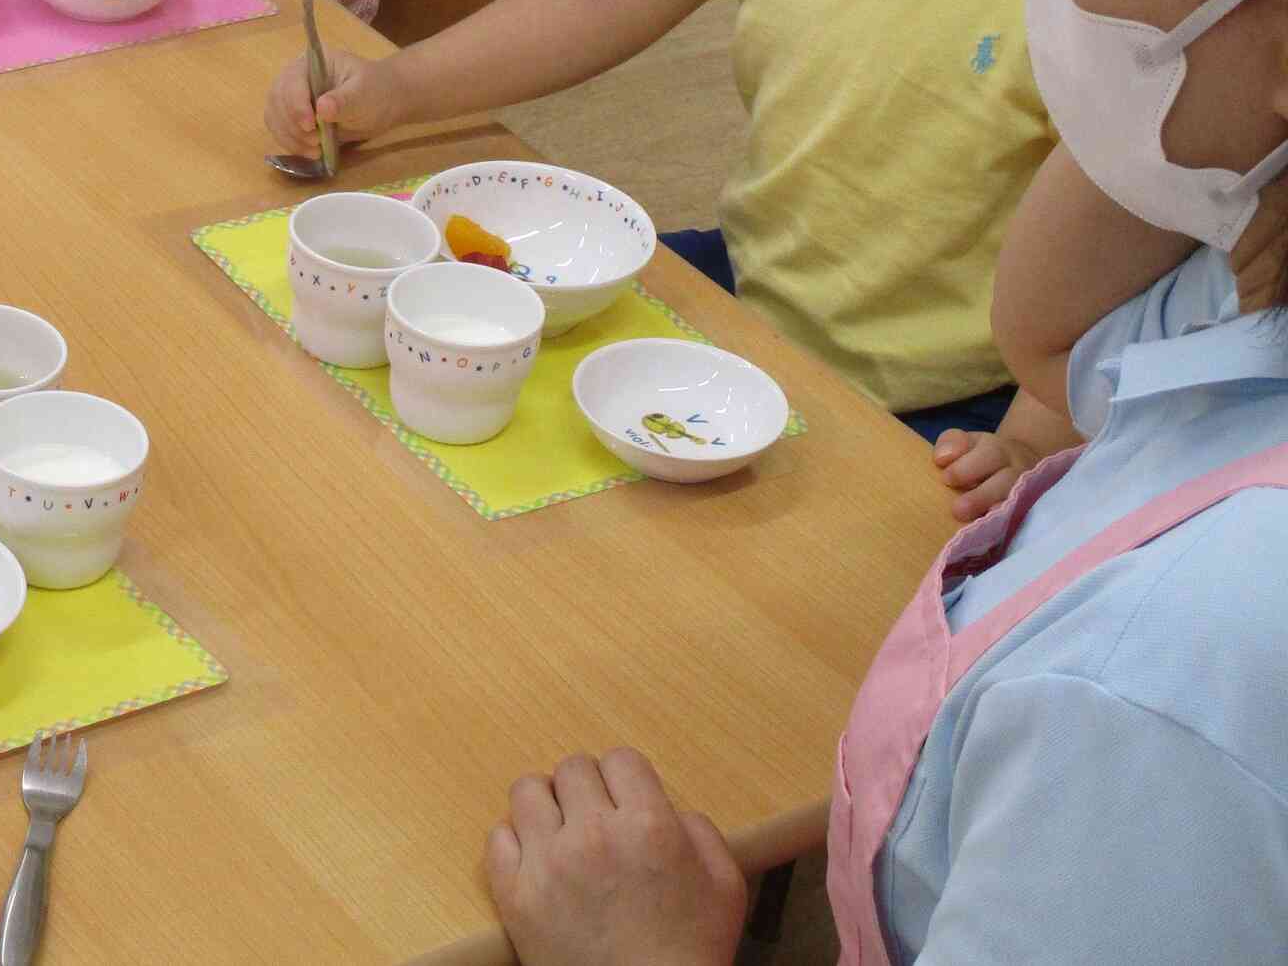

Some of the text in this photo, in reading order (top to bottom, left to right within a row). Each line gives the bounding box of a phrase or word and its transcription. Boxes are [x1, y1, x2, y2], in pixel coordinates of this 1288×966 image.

[471, 175, 482, 187] D
[497, 171, 509, 184] E
[520, 178, 529, 190] F
[596, 190, 604, 202] I
[312, 274, 321, 286] X
[418, 351, 431, 363] N
[42, 498, 55, 512] U
[83, 497, 94, 510] V
